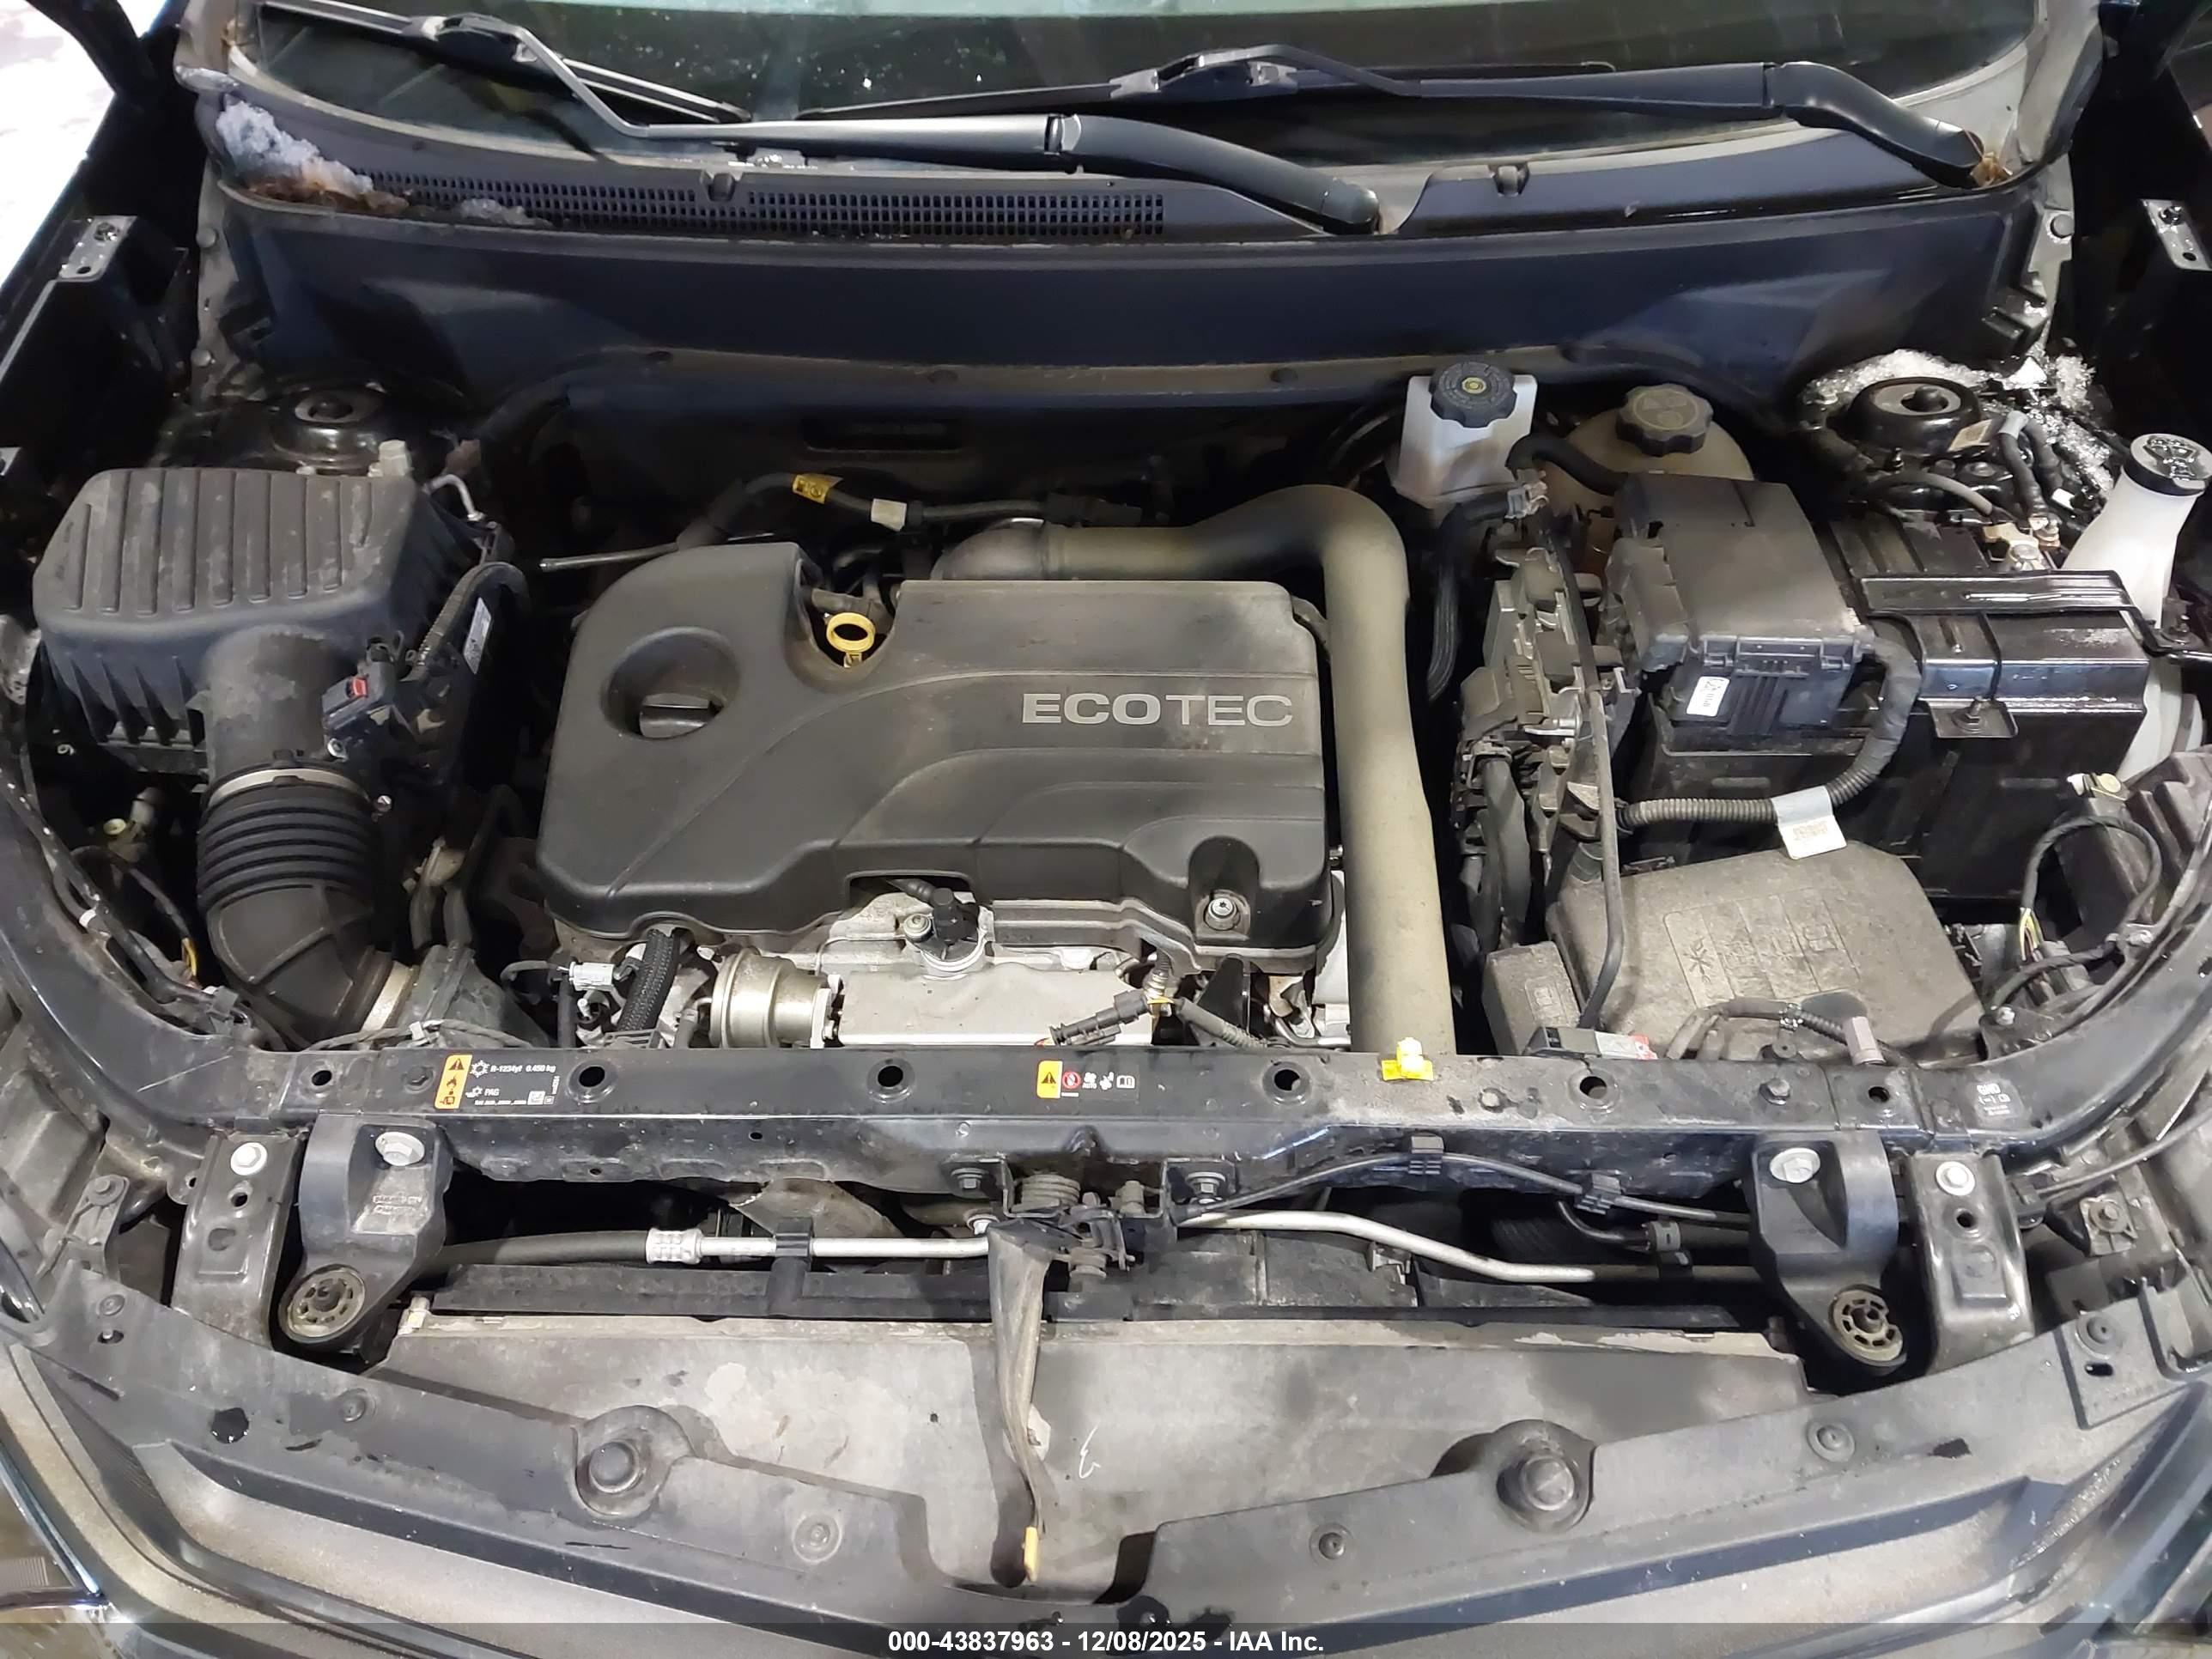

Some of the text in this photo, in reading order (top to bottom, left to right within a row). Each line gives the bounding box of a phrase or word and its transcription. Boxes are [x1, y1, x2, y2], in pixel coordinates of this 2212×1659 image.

[1022, 693, 1292, 726] ECOTEC
[489, 1065, 523, 1073] R-1234yf
[545, 1065, 556, 1073] kg
